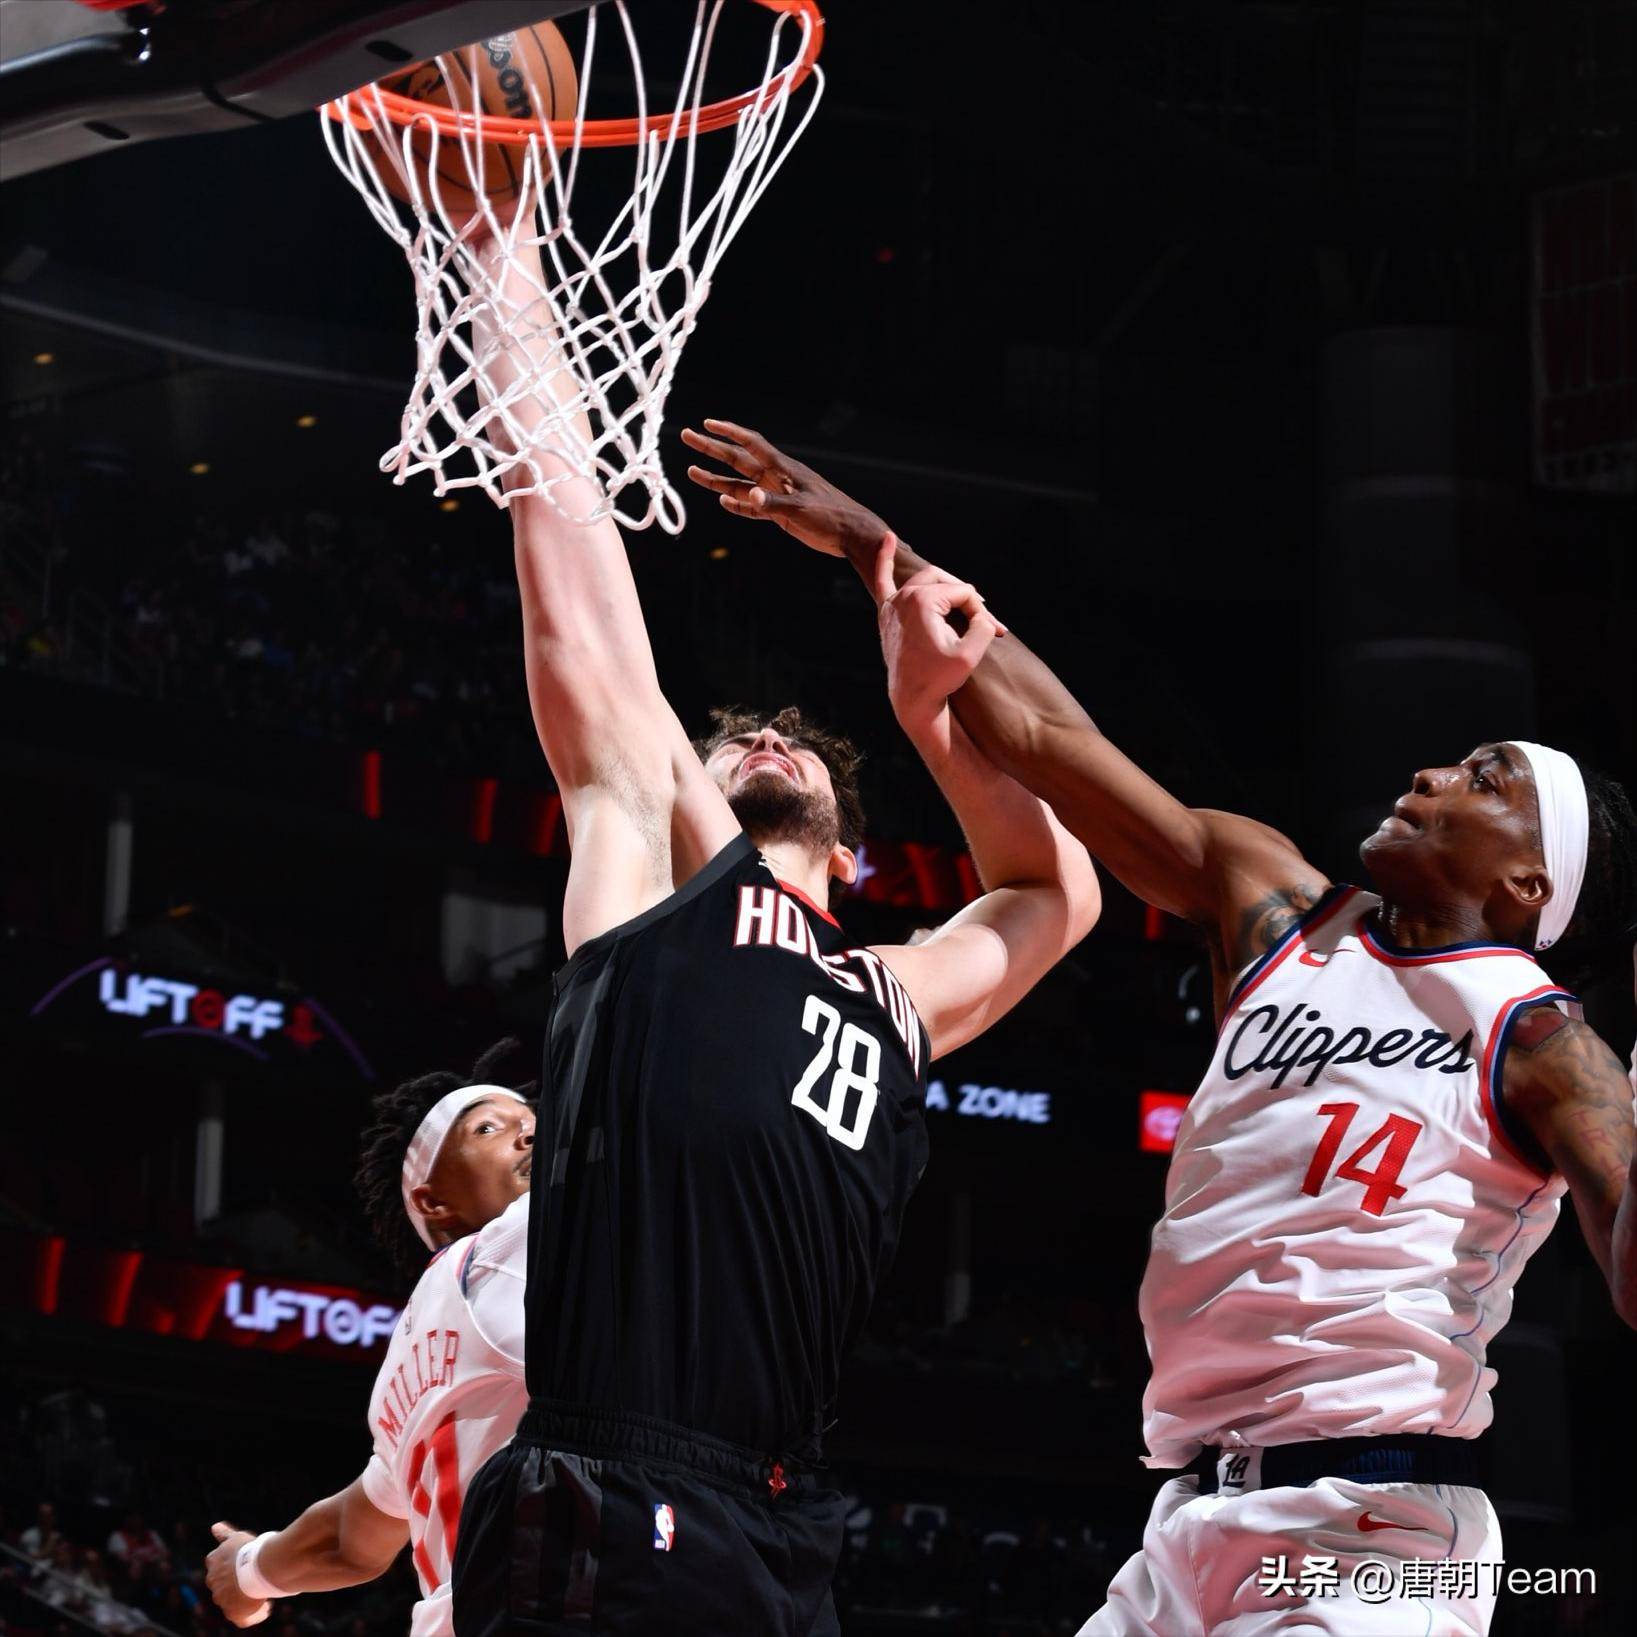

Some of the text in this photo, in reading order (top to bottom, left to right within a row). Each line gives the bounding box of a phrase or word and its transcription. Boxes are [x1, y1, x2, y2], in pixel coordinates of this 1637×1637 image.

[101, 968, 283, 1040] LIFTOFF
[1223, 1003, 1475, 1090] Clippers
[791, 994, 881, 1151] 28
[957, 1083, 1052, 1124] ZONE
[1301, 1102, 1423, 1217] 14
[225, 1281, 402, 1348] LIFTOF
[377, 1329, 460, 1448] MILLER
